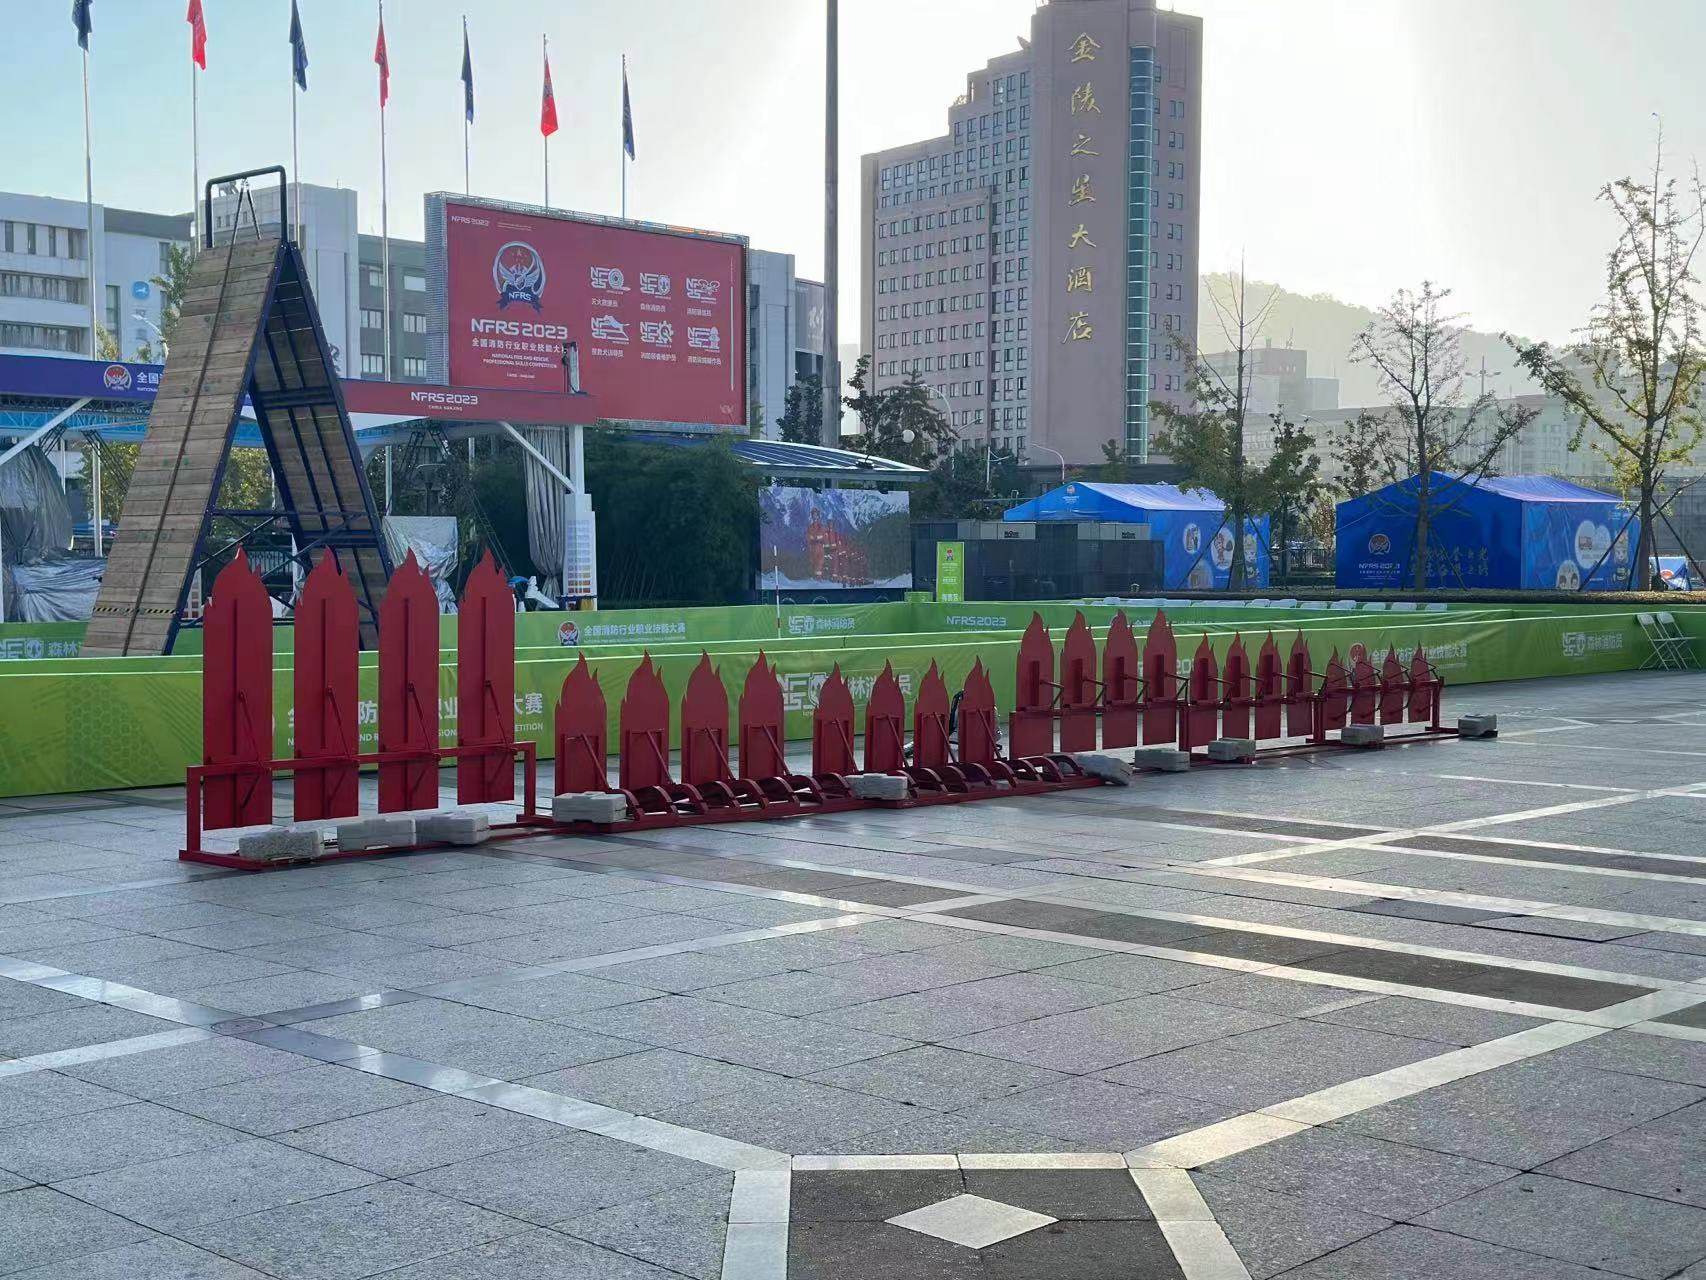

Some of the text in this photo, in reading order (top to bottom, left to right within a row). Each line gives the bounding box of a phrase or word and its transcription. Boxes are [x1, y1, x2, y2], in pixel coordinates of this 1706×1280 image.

[1060, 32, 1102, 344] 金陵之星大酒店
[508, 291, 532, 302] NFRS
[48, 640, 83, 656] 森林
